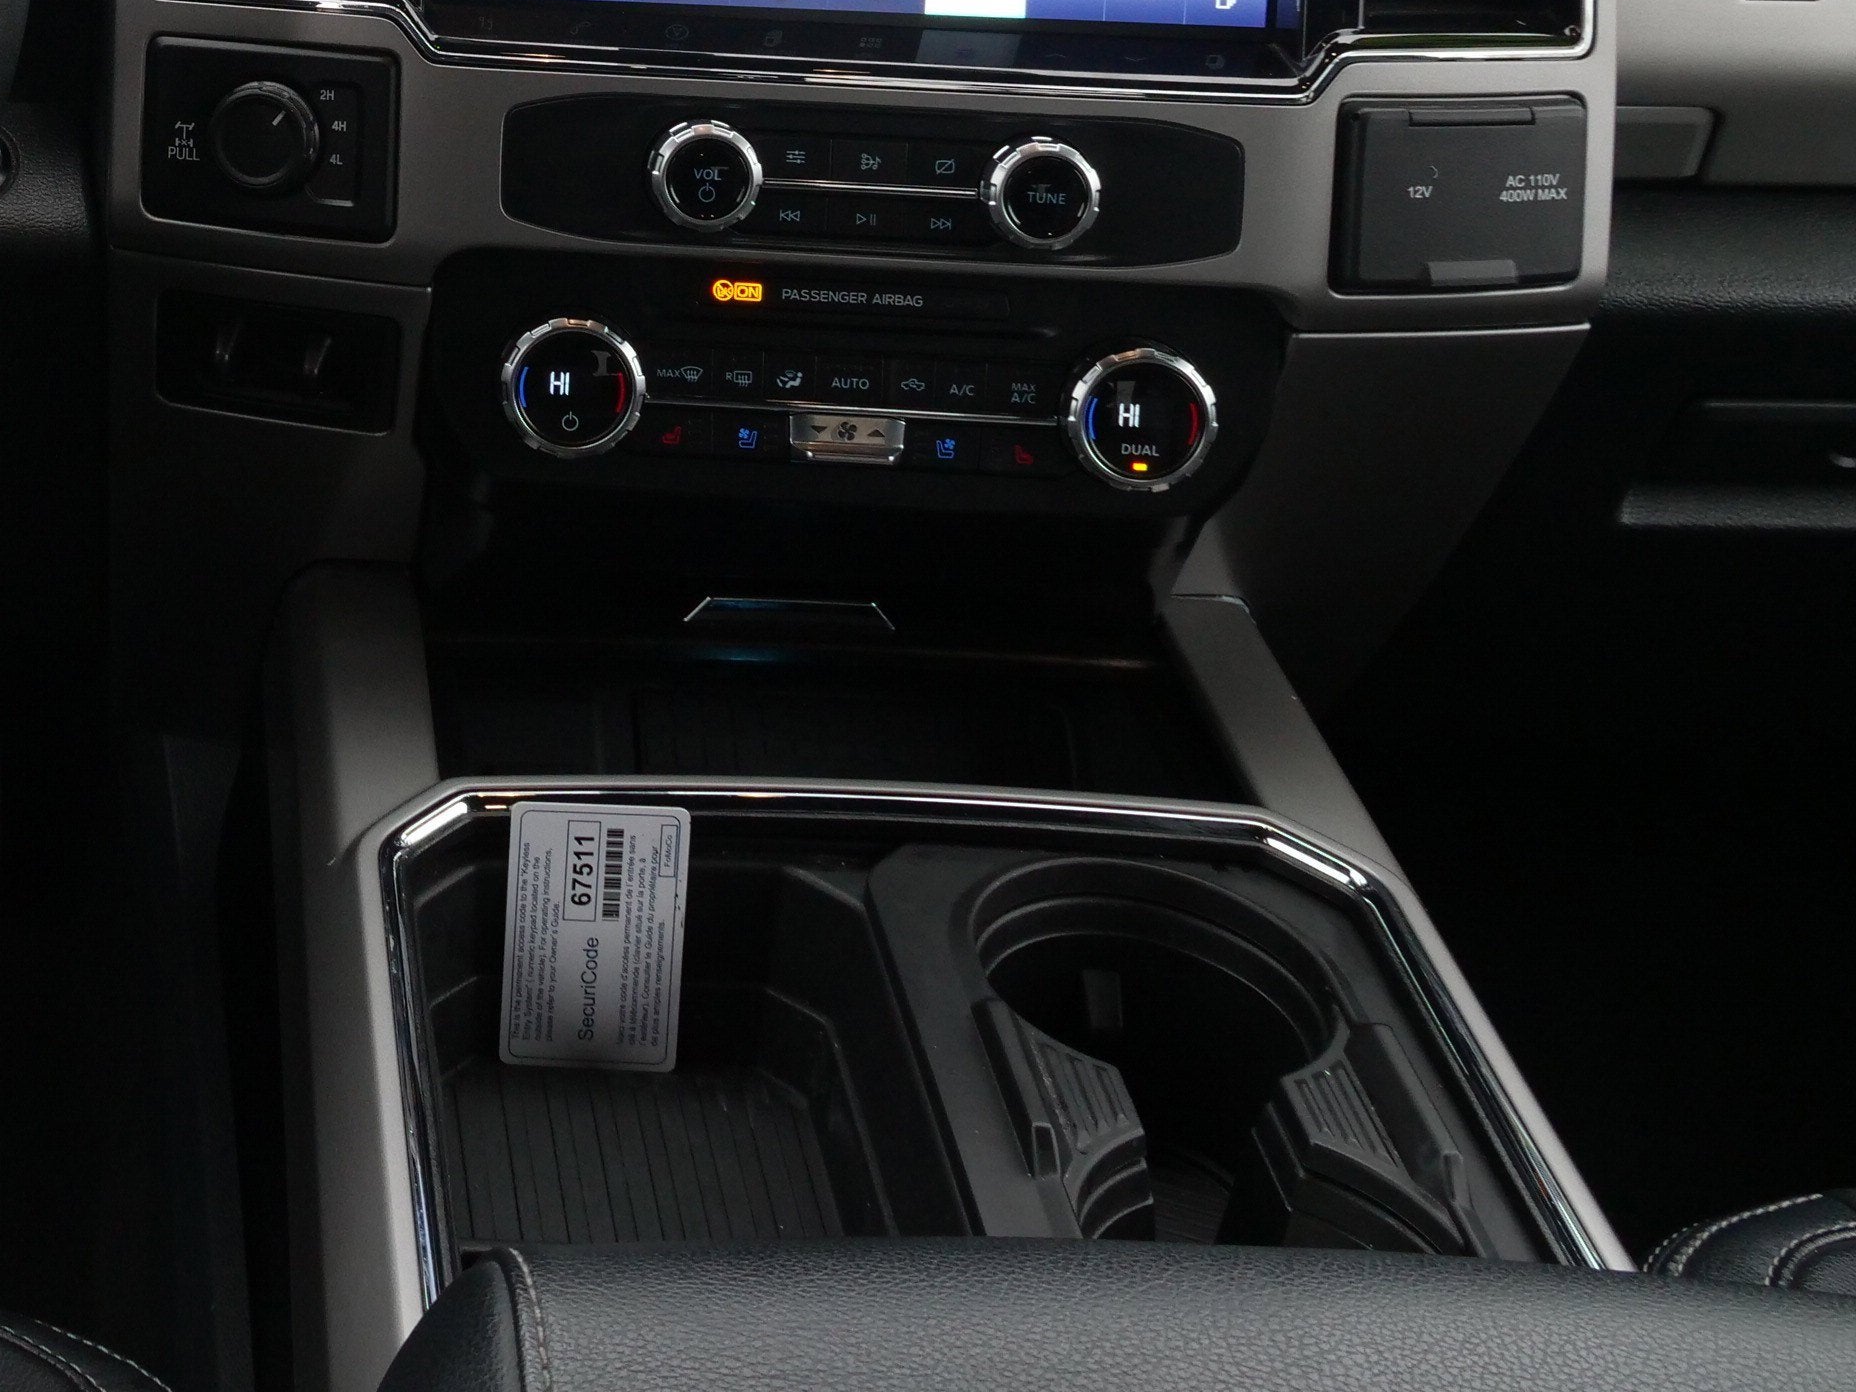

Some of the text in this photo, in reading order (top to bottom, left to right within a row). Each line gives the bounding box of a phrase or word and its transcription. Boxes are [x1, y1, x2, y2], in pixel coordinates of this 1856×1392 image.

[320, 89, 335, 101] 2H
[331, 120, 347, 132] 4H
[167, 146, 200, 161] PULL
[329, 154, 343, 166] 4L
[694, 167, 722, 181] VOL
[1505, 173, 1560, 188] AC 110V
[1026, 191, 1067, 205] TUNE
[1407, 186, 1433, 199] 12V
[1499, 188, 1568, 202] 400W MAX
[782, 288, 923, 307] PASSENGER AIRBAG
[657, 368, 681, 379] MAX
[549, 370, 570, 396] HI
[831, 377, 870, 390] AUTO
[1011, 382, 1036, 393] MAX
[949, 384, 975, 397] A/C
[1011, 392, 1036, 405] A/C
[1118, 403, 1140, 428] HI
[1121, 443, 1160, 457] DUAL
[570, 835, 595, 906] 67511
[578, 936, 600, 1042] SecuriCode
